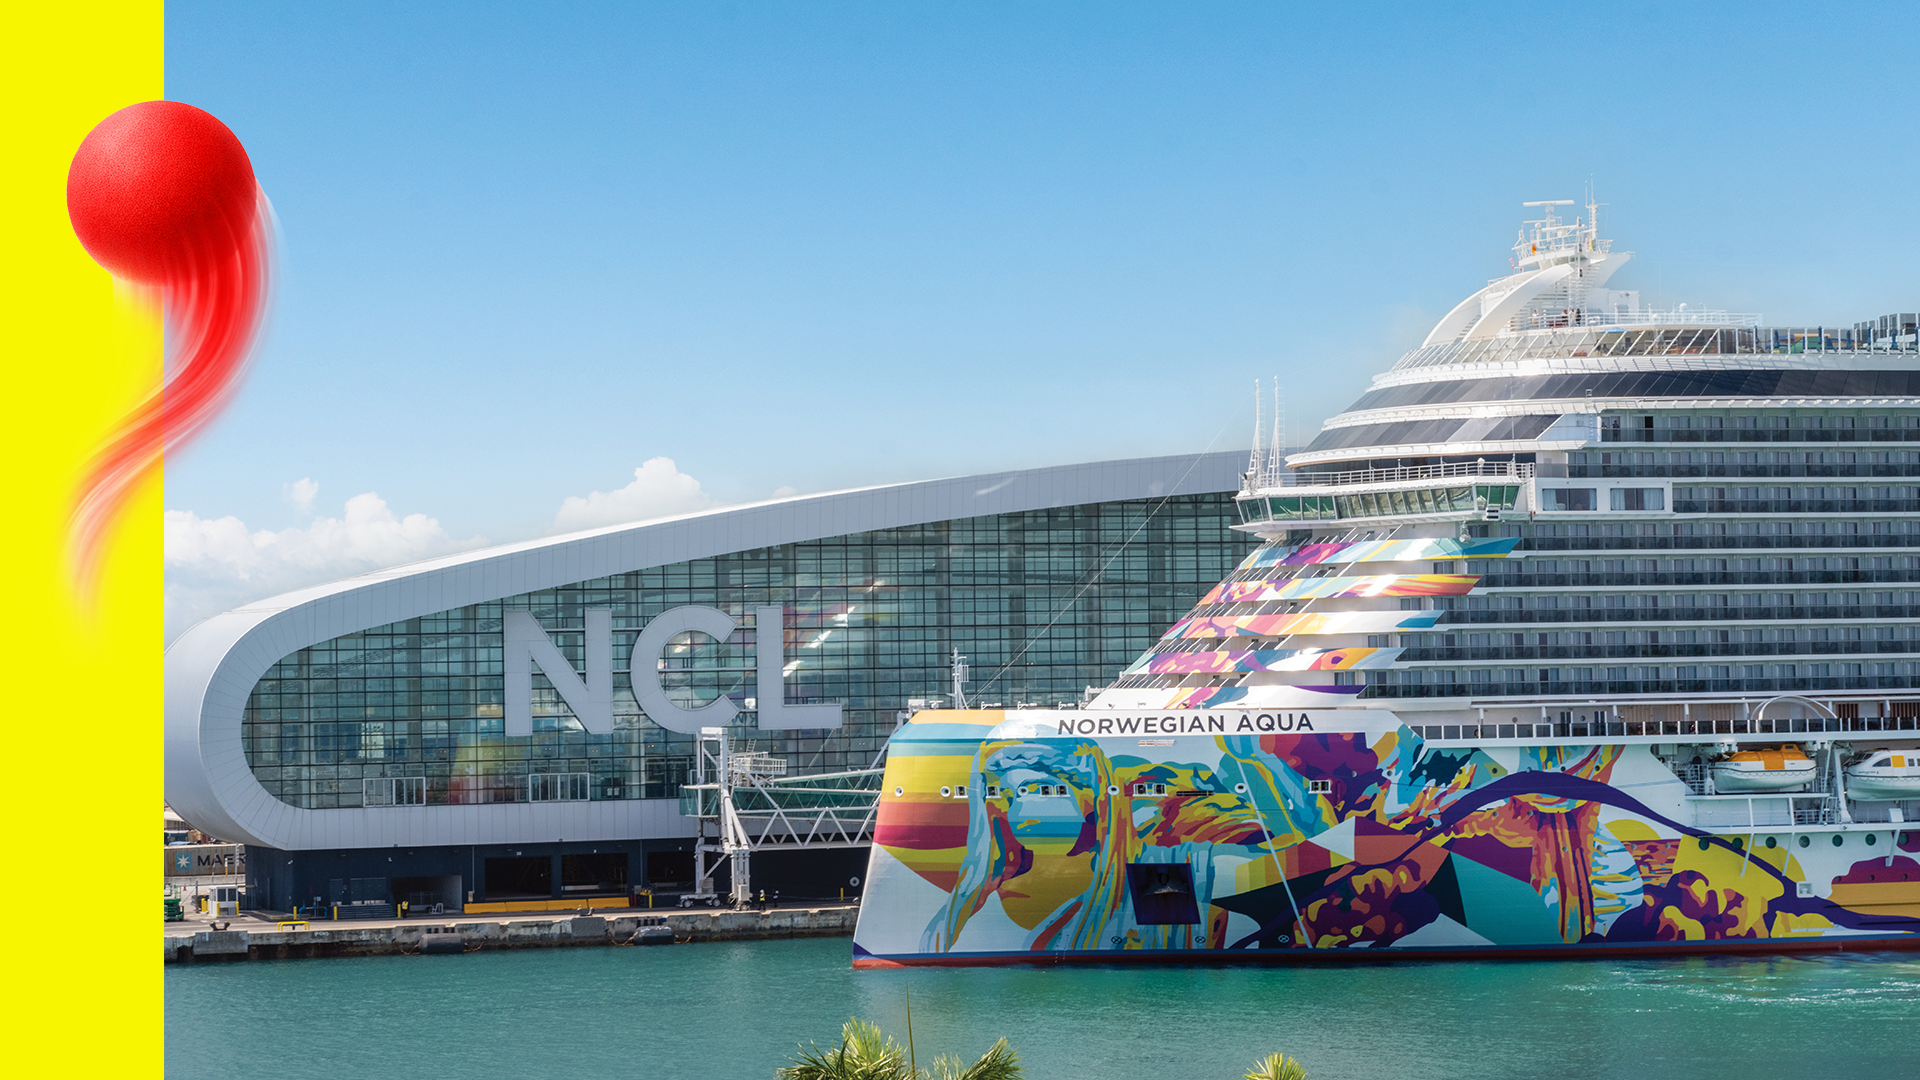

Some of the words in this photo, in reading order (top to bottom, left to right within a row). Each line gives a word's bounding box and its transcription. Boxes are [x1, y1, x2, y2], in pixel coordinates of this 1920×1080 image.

[503, 605, 843, 737] NCL
[1058, 715, 1225, 735] NORWEGIAN
[1236, 713, 1315, 732] AQUA
